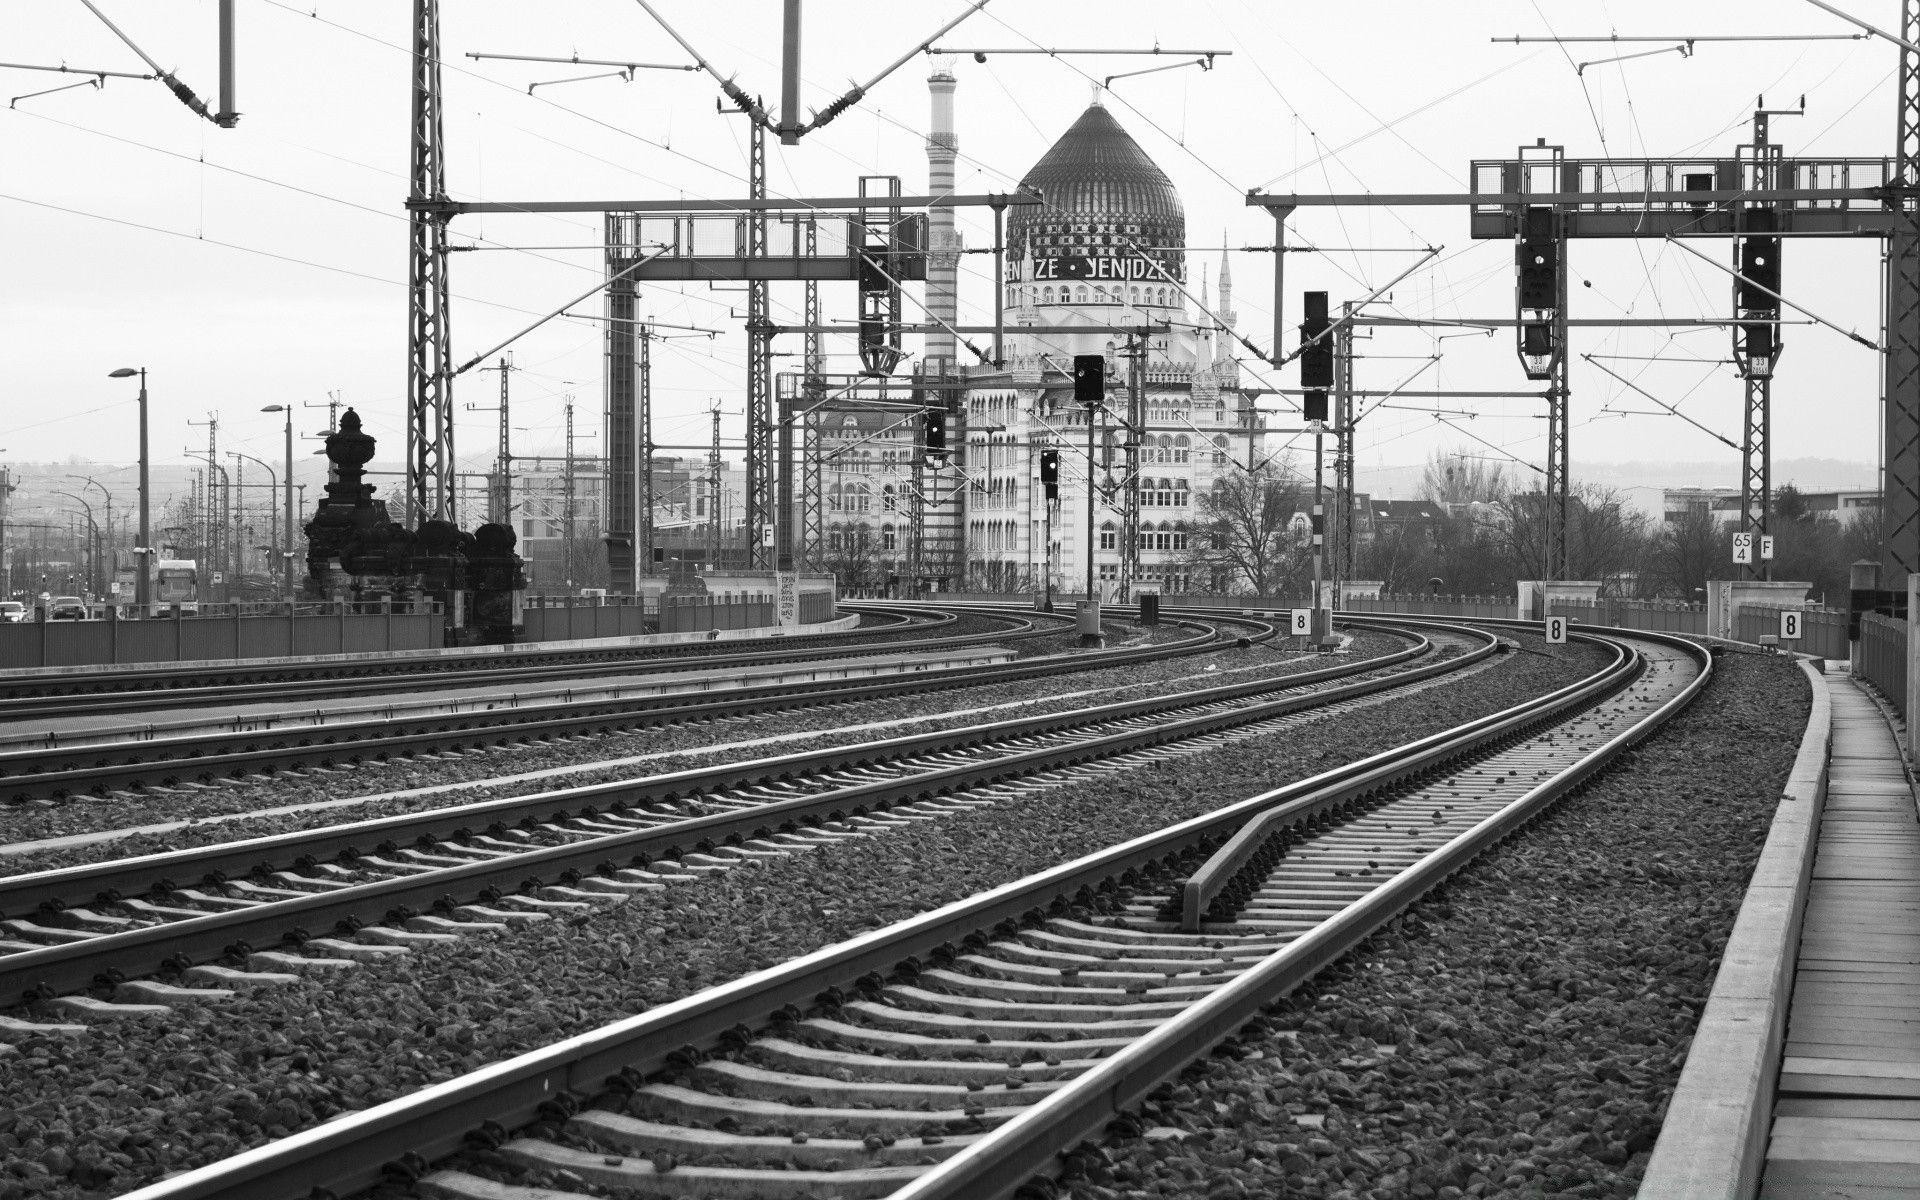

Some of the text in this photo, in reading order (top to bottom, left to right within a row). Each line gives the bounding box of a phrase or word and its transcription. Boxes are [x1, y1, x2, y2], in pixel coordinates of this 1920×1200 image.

[1085, 257, 1167, 280] YENIDZE
[764, 529, 772, 542] F
[1734, 534, 1751, 547] 65
[1763, 540, 1771, 554] F
[1737, 548, 1746, 561] 4
[1297, 615, 1305, 629] 8
[1786, 614, 1796, 636] 8
[1551, 619, 1561, 640] 8
